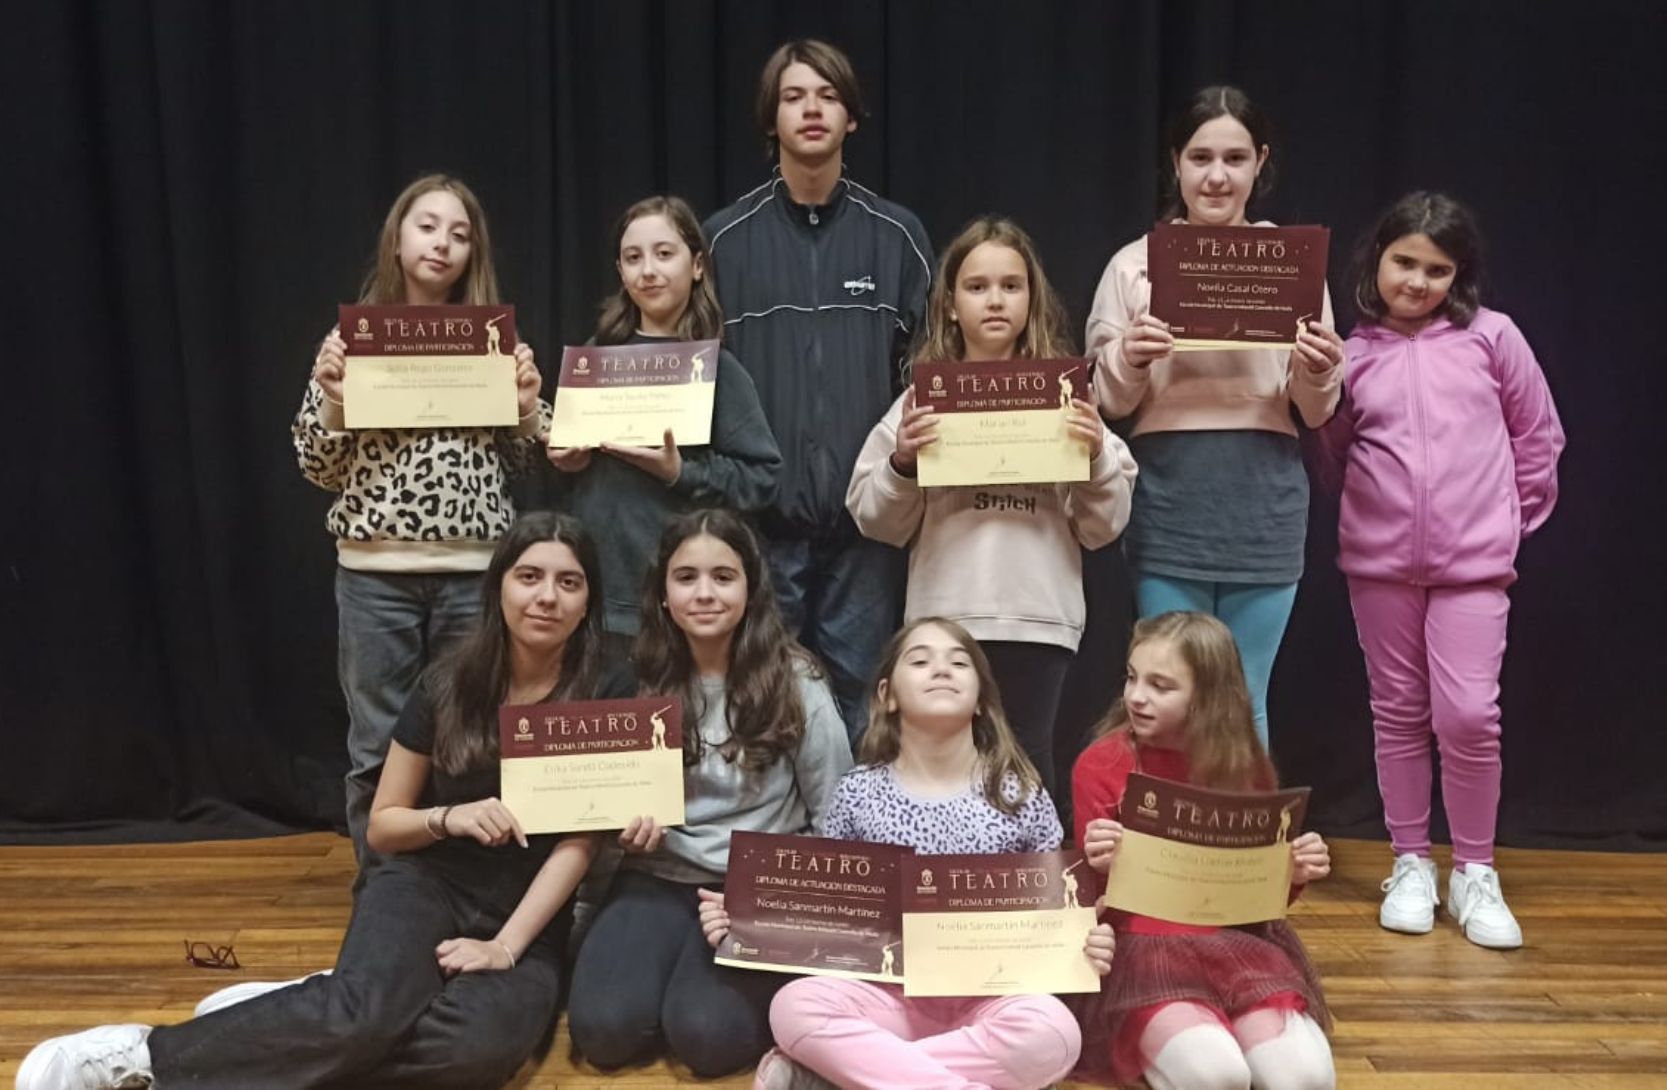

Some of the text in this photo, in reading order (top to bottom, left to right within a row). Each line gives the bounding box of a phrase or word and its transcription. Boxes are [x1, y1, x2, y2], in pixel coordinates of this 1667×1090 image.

[1198, 243, 1285, 258] TEATRO
[1227, 284, 1250, 293] Casal
[384, 322, 473, 338] TEATRO
[601, 355, 681, 371] TEATRO
[957, 376, 1047, 393] TEATRO
[544, 717, 638, 736] TEATRO
[1173, 803, 1270, 830] TEATRO
[776, 853, 871, 877] TEATRO
[755, 875, 788, 886] DIPLOMA
[949, 873, 1048, 890] TEATRO
[757, 897, 787, 909] Noelia
